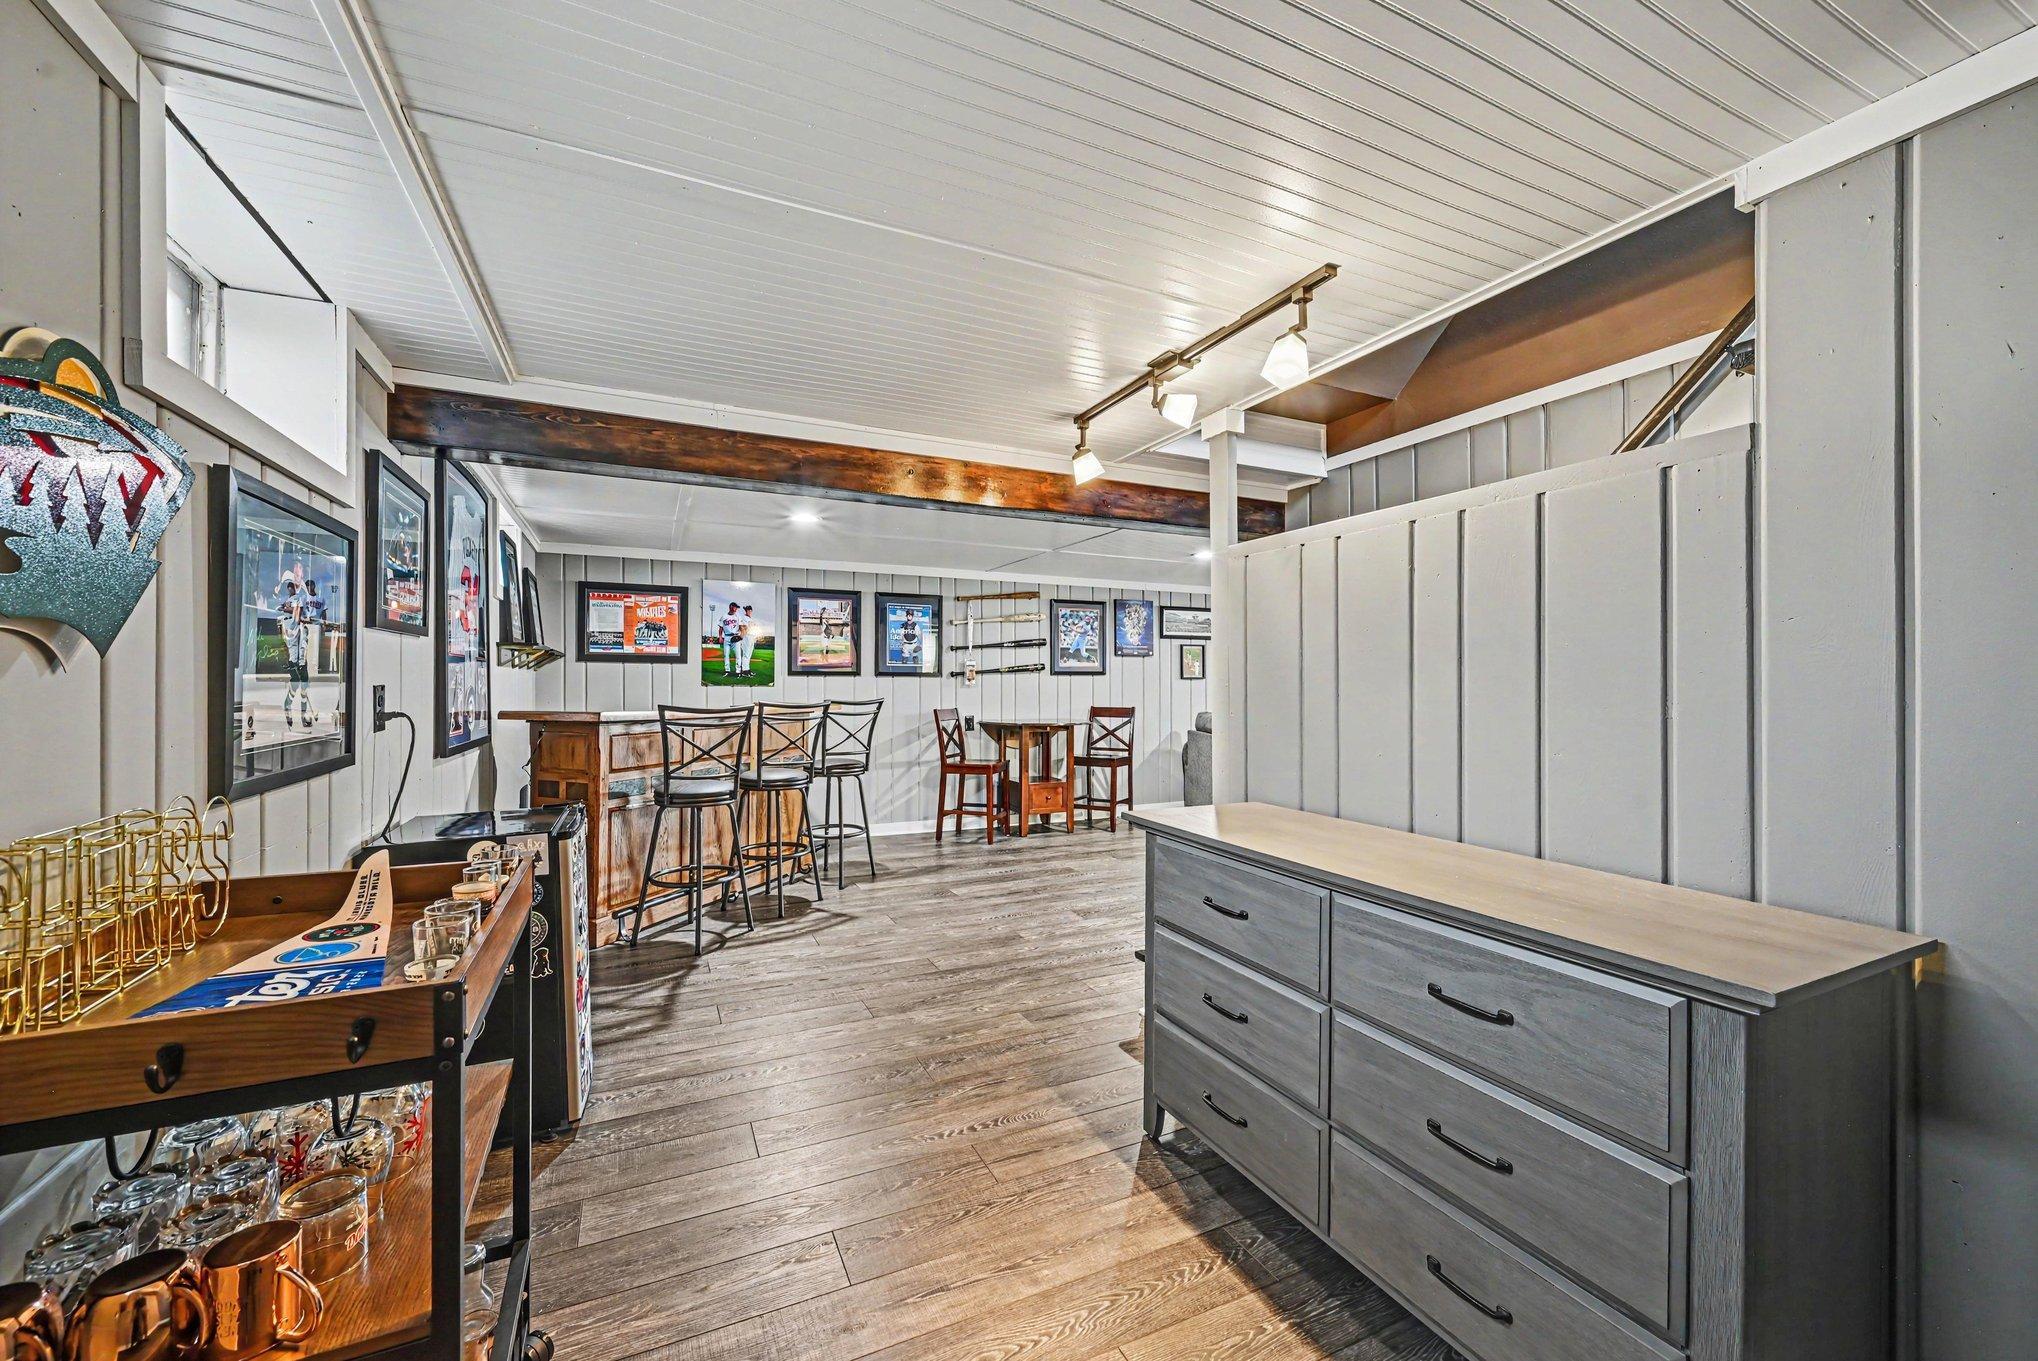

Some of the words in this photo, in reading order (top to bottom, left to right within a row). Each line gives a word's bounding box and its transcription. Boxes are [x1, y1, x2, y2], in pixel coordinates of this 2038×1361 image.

[370, 871, 381, 890] WILD
[224, 968, 345, 1007] ter
[308, 974, 347, 995] SIC
